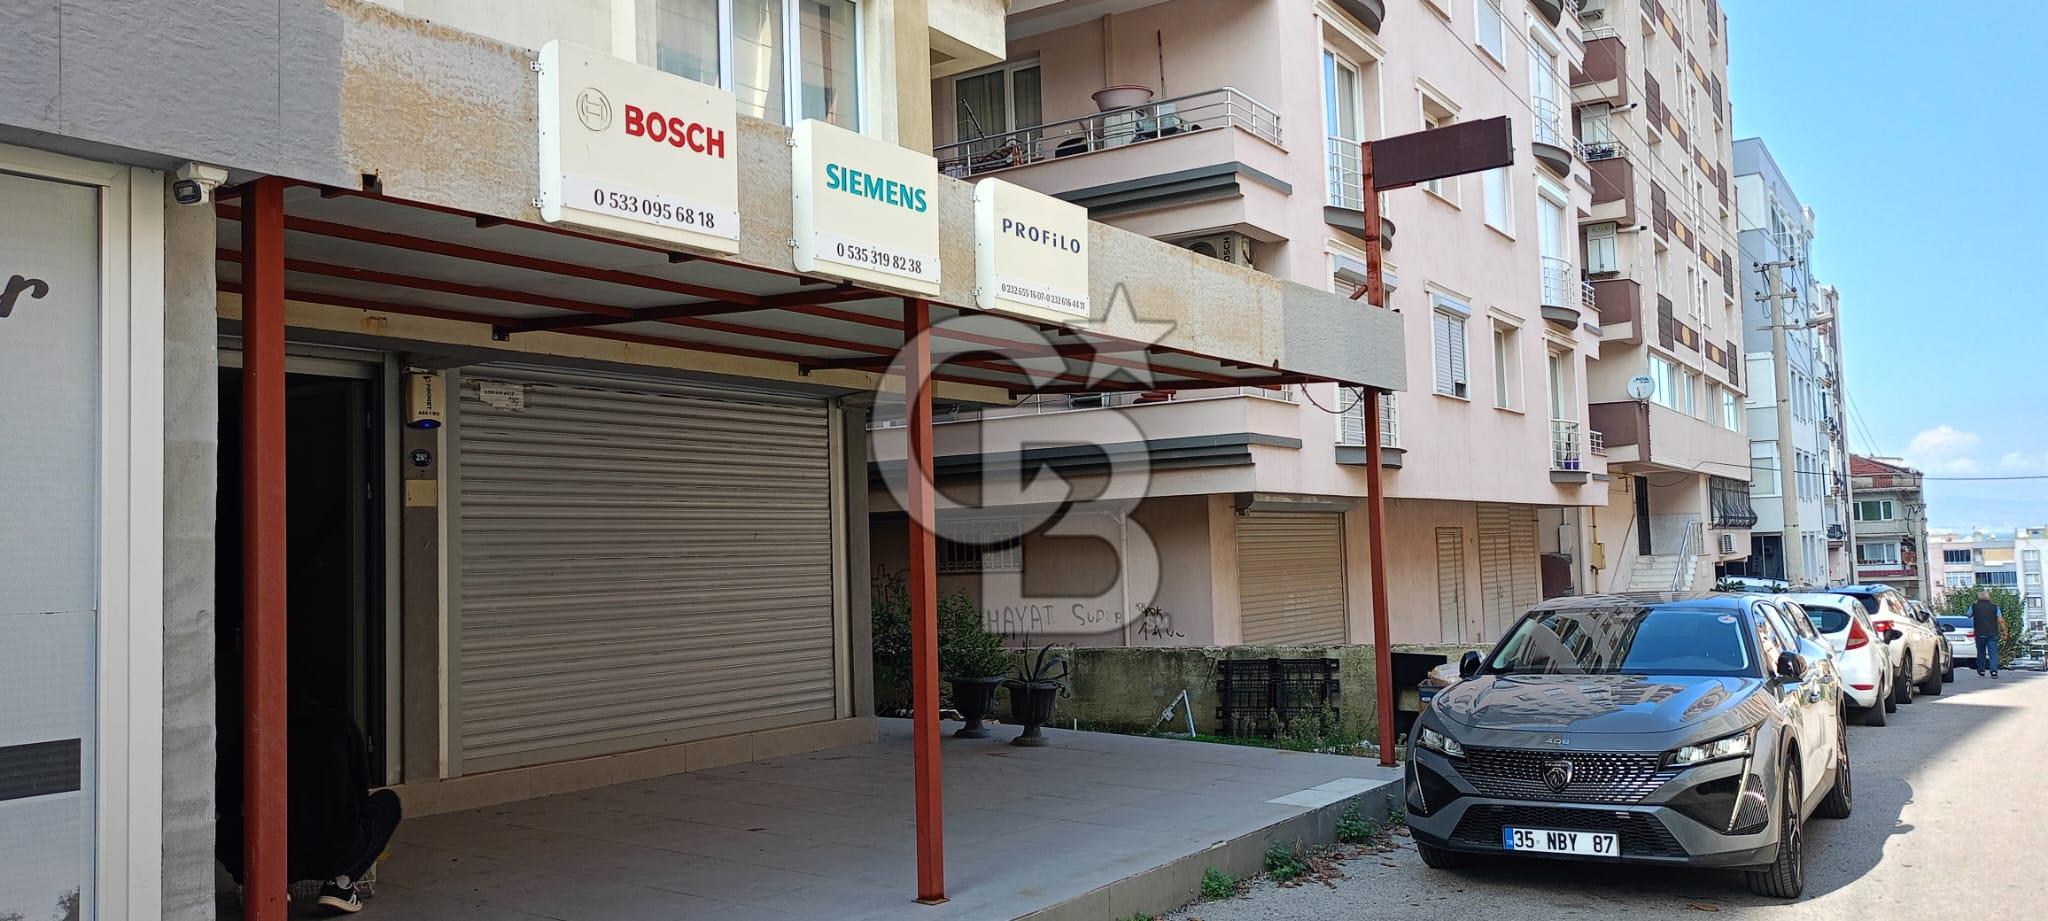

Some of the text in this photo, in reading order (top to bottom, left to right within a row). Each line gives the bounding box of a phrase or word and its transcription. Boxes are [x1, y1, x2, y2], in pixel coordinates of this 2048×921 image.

[625, 104, 725, 159] BOSCH
[826, 163, 927, 213] SIEMENS
[594, 188, 715, 229] 0 533 095 68 18
[836, 242, 922, 274] 0 535 319 82 38
[1223, 237, 1231, 261] OSCH
[1006, 284, 1018, 295] 232
[1018, 287, 1030, 298] 655
[1051, 295, 1061, 305] 232
[1072, 300, 1079, 309] 44
[1514, 830, 1614, 854] 35 NBY 87
